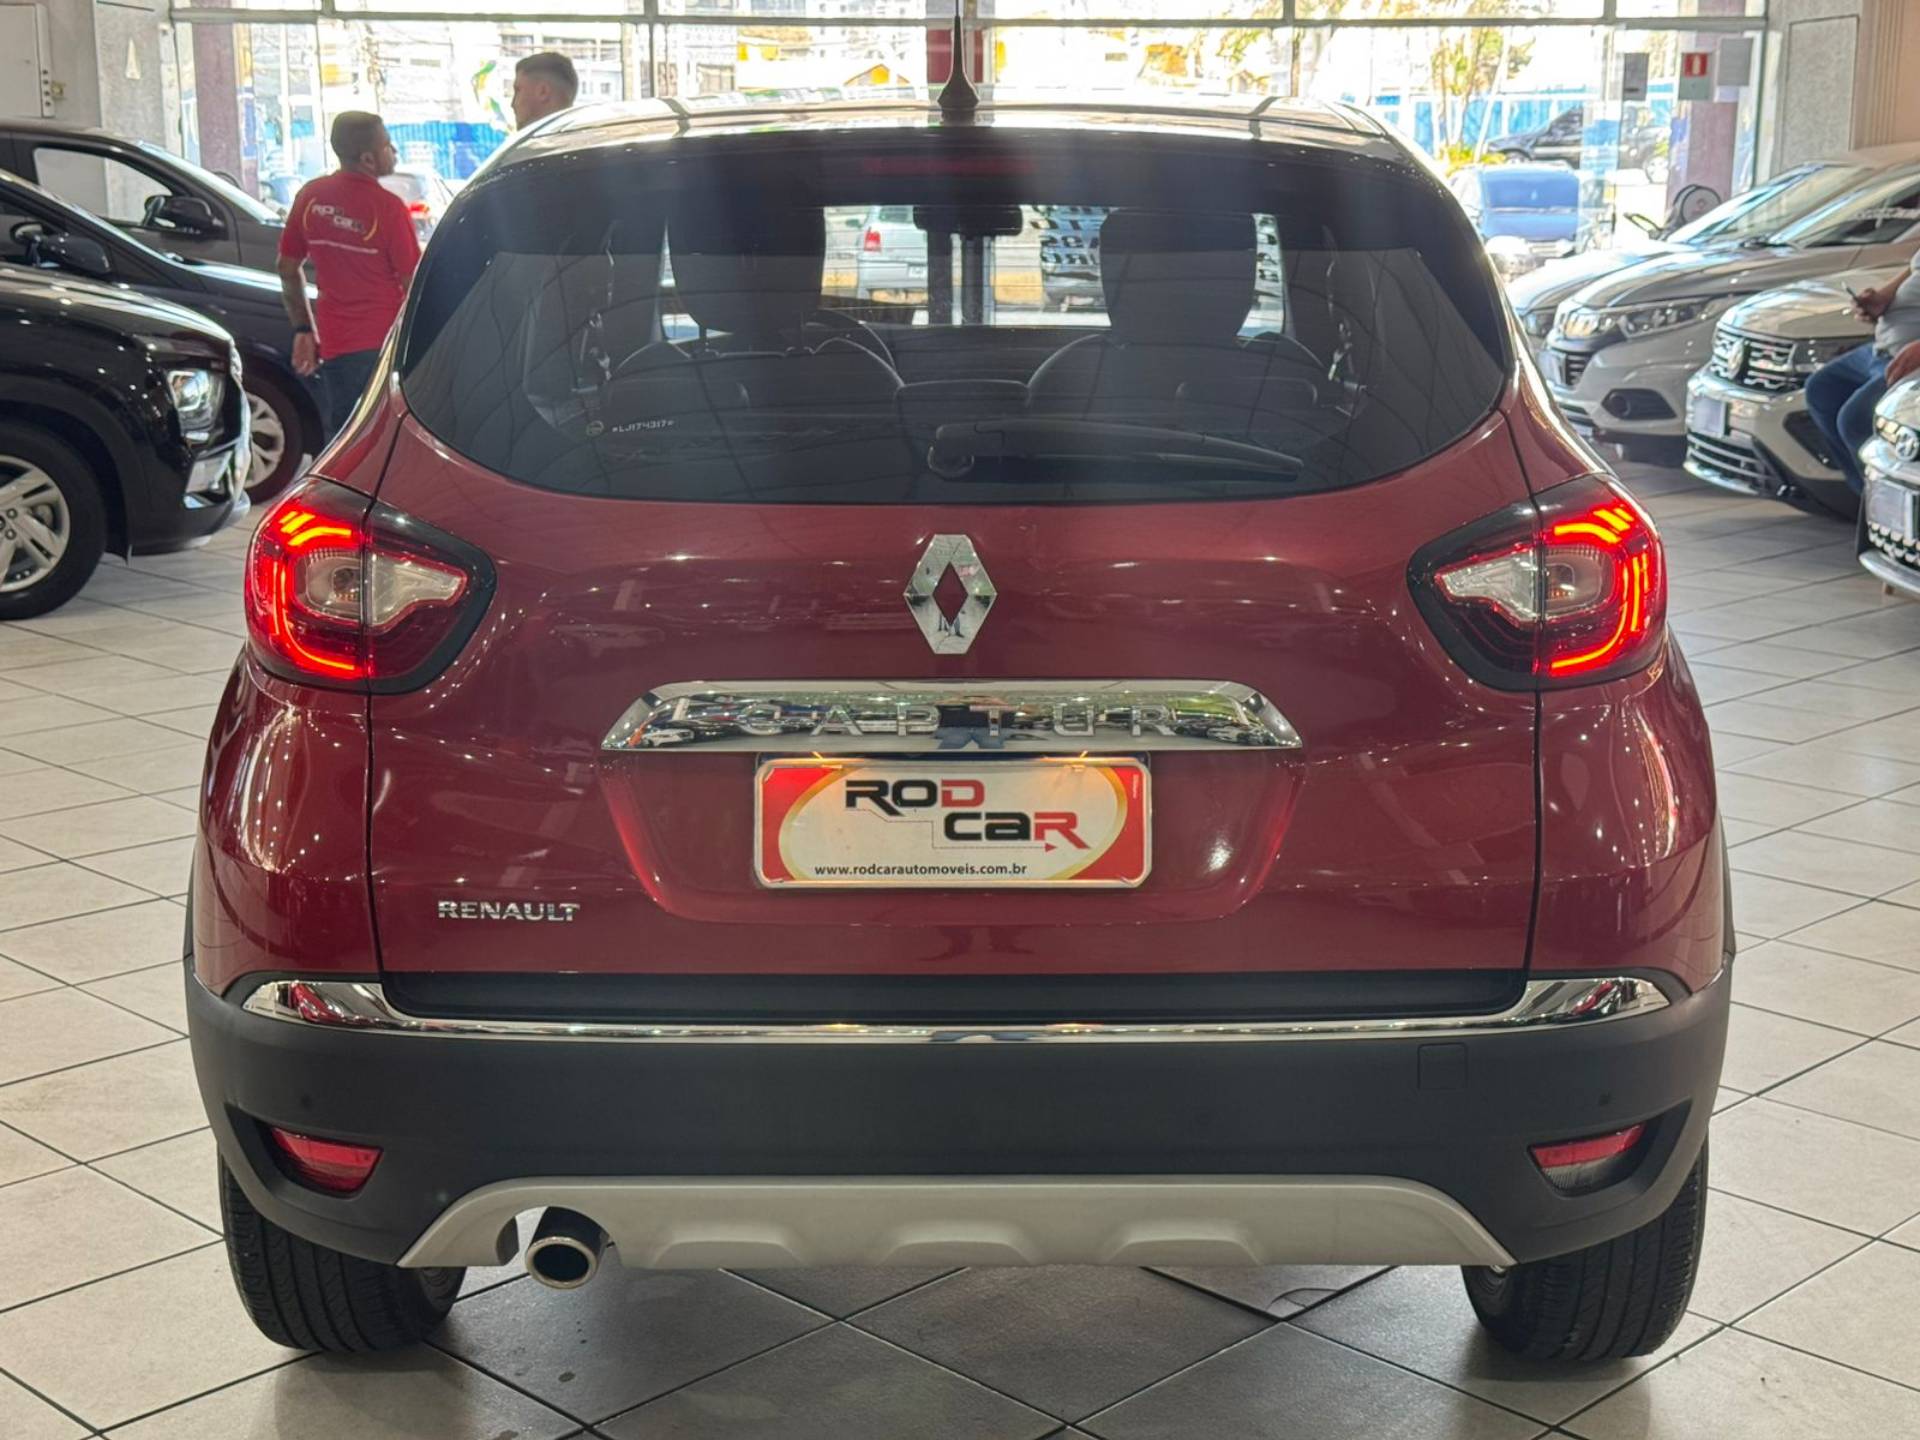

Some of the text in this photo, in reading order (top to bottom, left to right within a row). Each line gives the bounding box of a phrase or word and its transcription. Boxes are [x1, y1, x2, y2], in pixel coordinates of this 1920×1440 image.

[736, 703, 1176, 736] CAPTUR
[845, 779, 985, 816] ROD
[814, 863, 1027, 876] www.rodcarautomoveis.com.br
[438, 900, 580, 922] RENAULT
